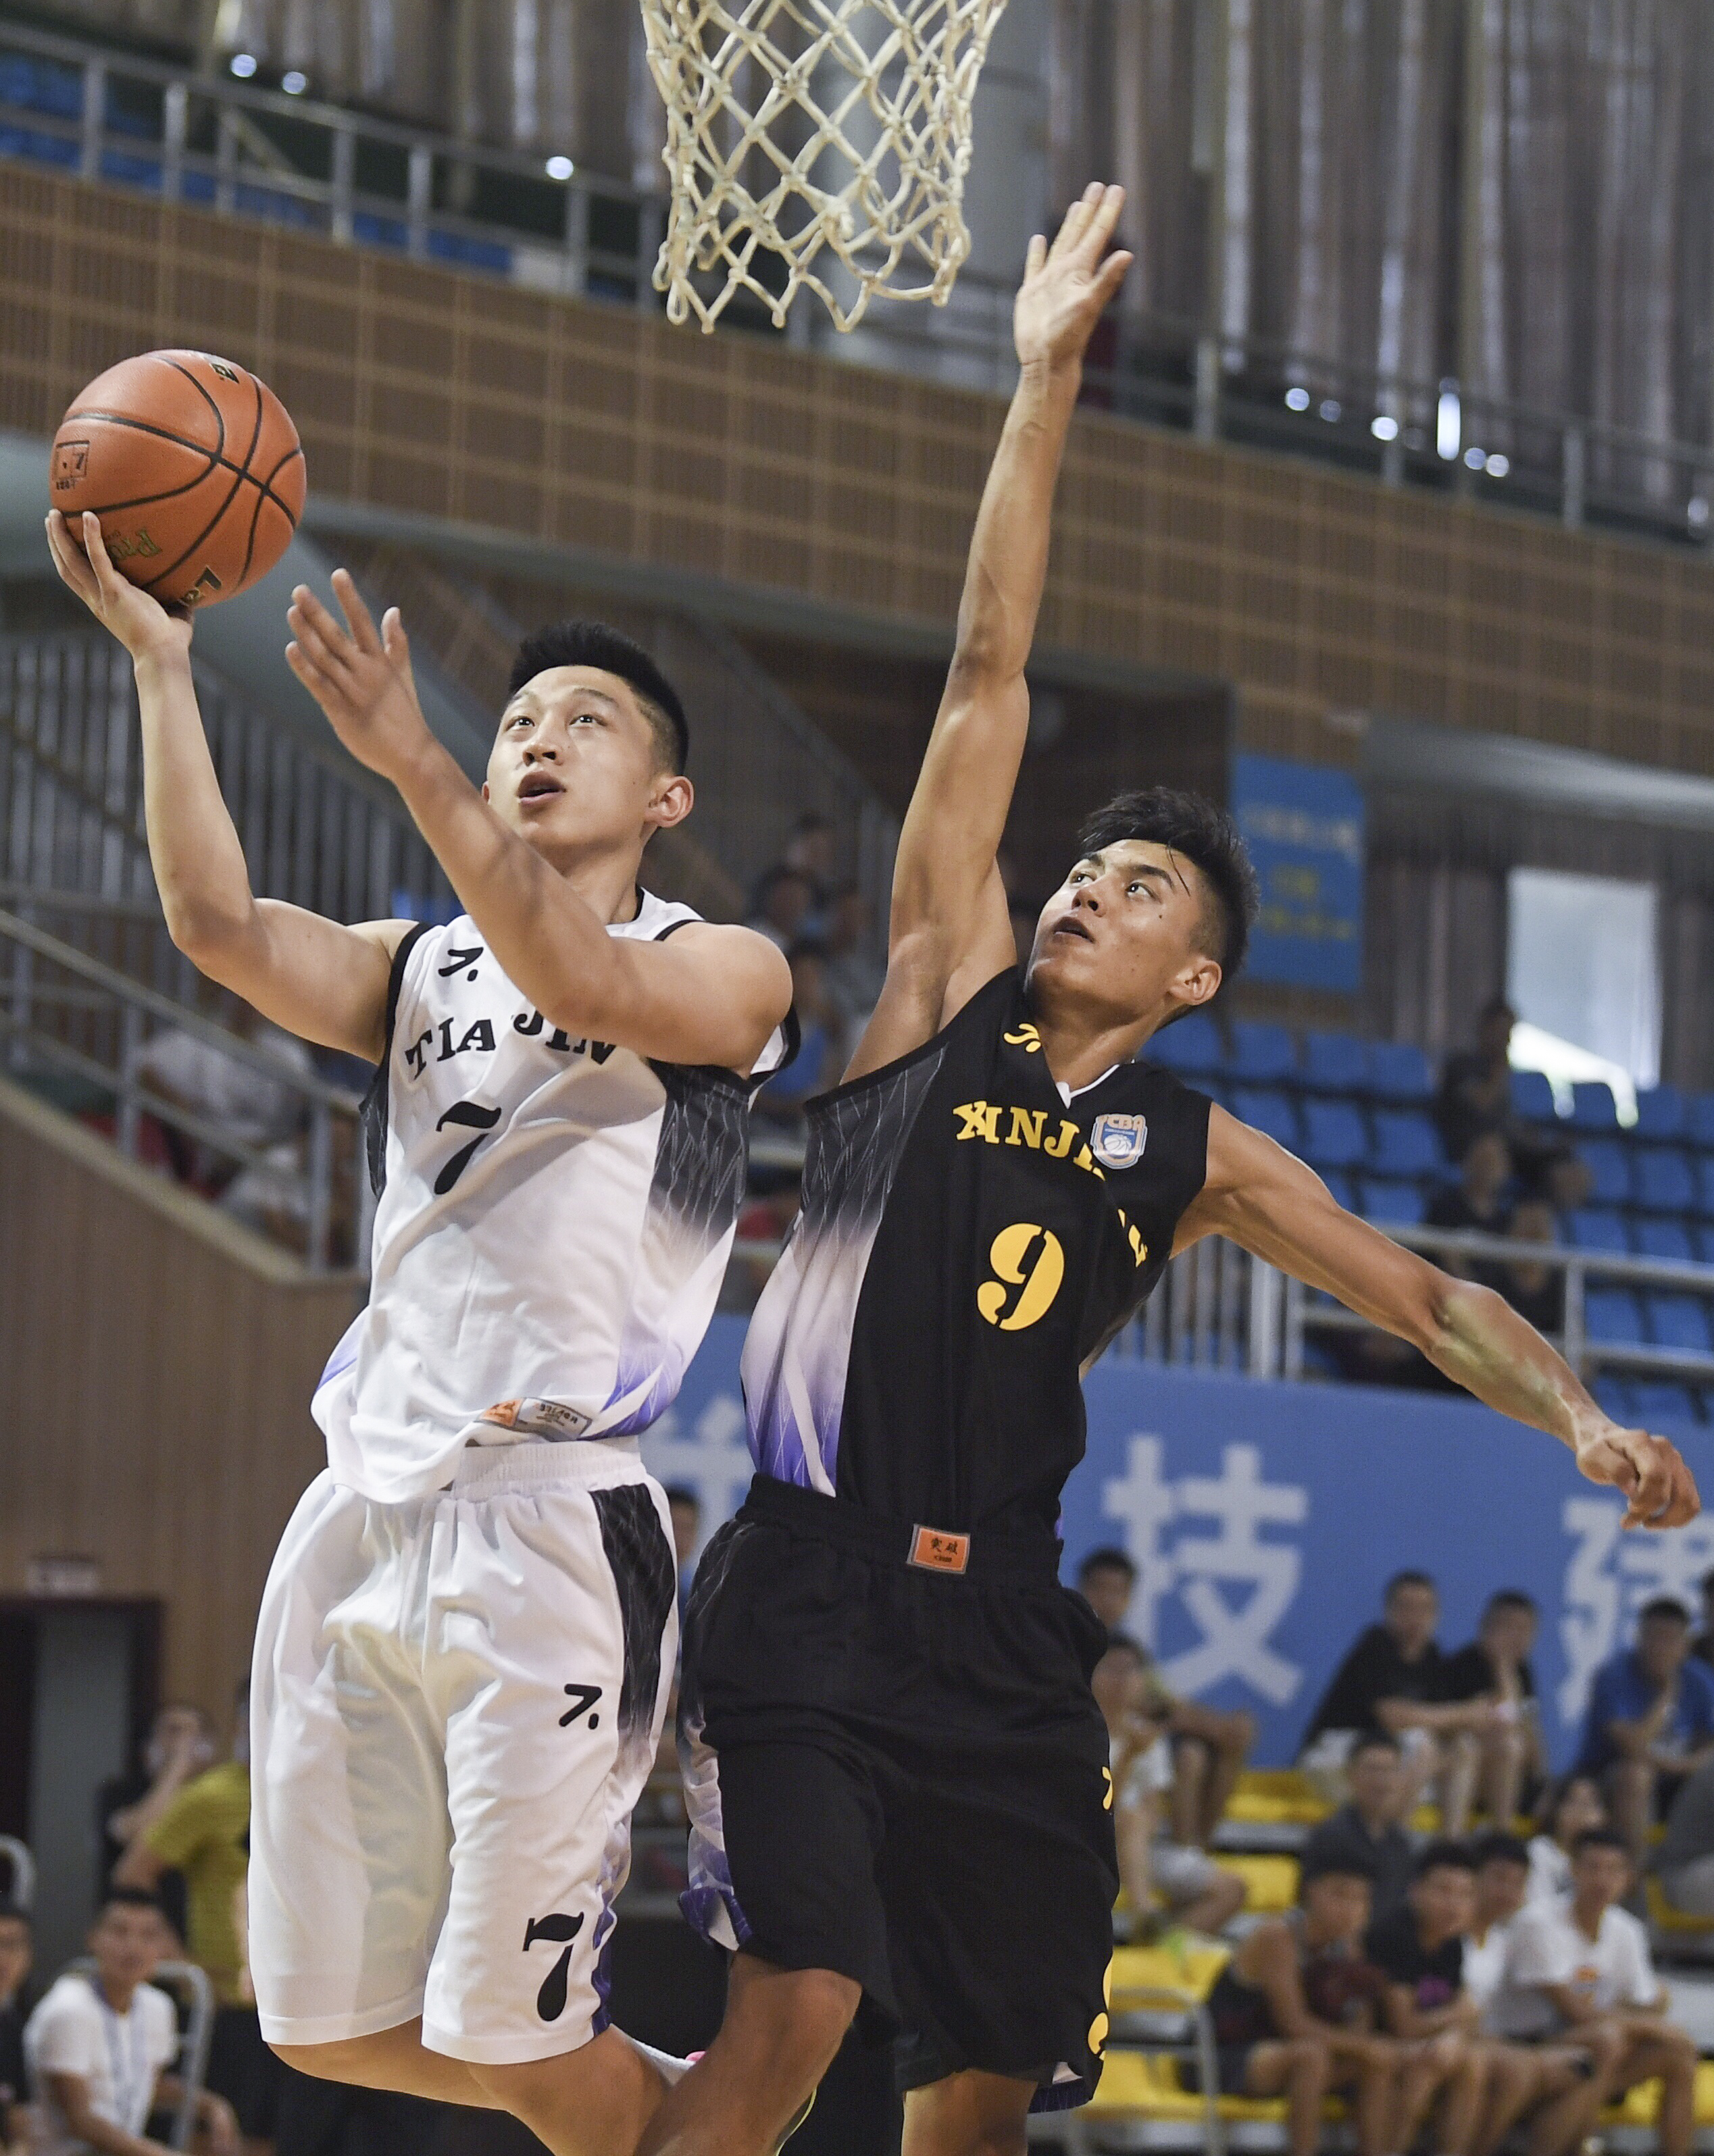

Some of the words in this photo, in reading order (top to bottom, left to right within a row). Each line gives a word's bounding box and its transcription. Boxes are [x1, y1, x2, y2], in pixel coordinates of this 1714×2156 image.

[405, 1009, 617, 1080] TIAJIN
[434, 1101, 502, 1196] 7
[1107, 1115, 1144, 1131] CBA
[977, 1223, 1065, 1331] 9
[522, 1911, 584, 2022] 7
